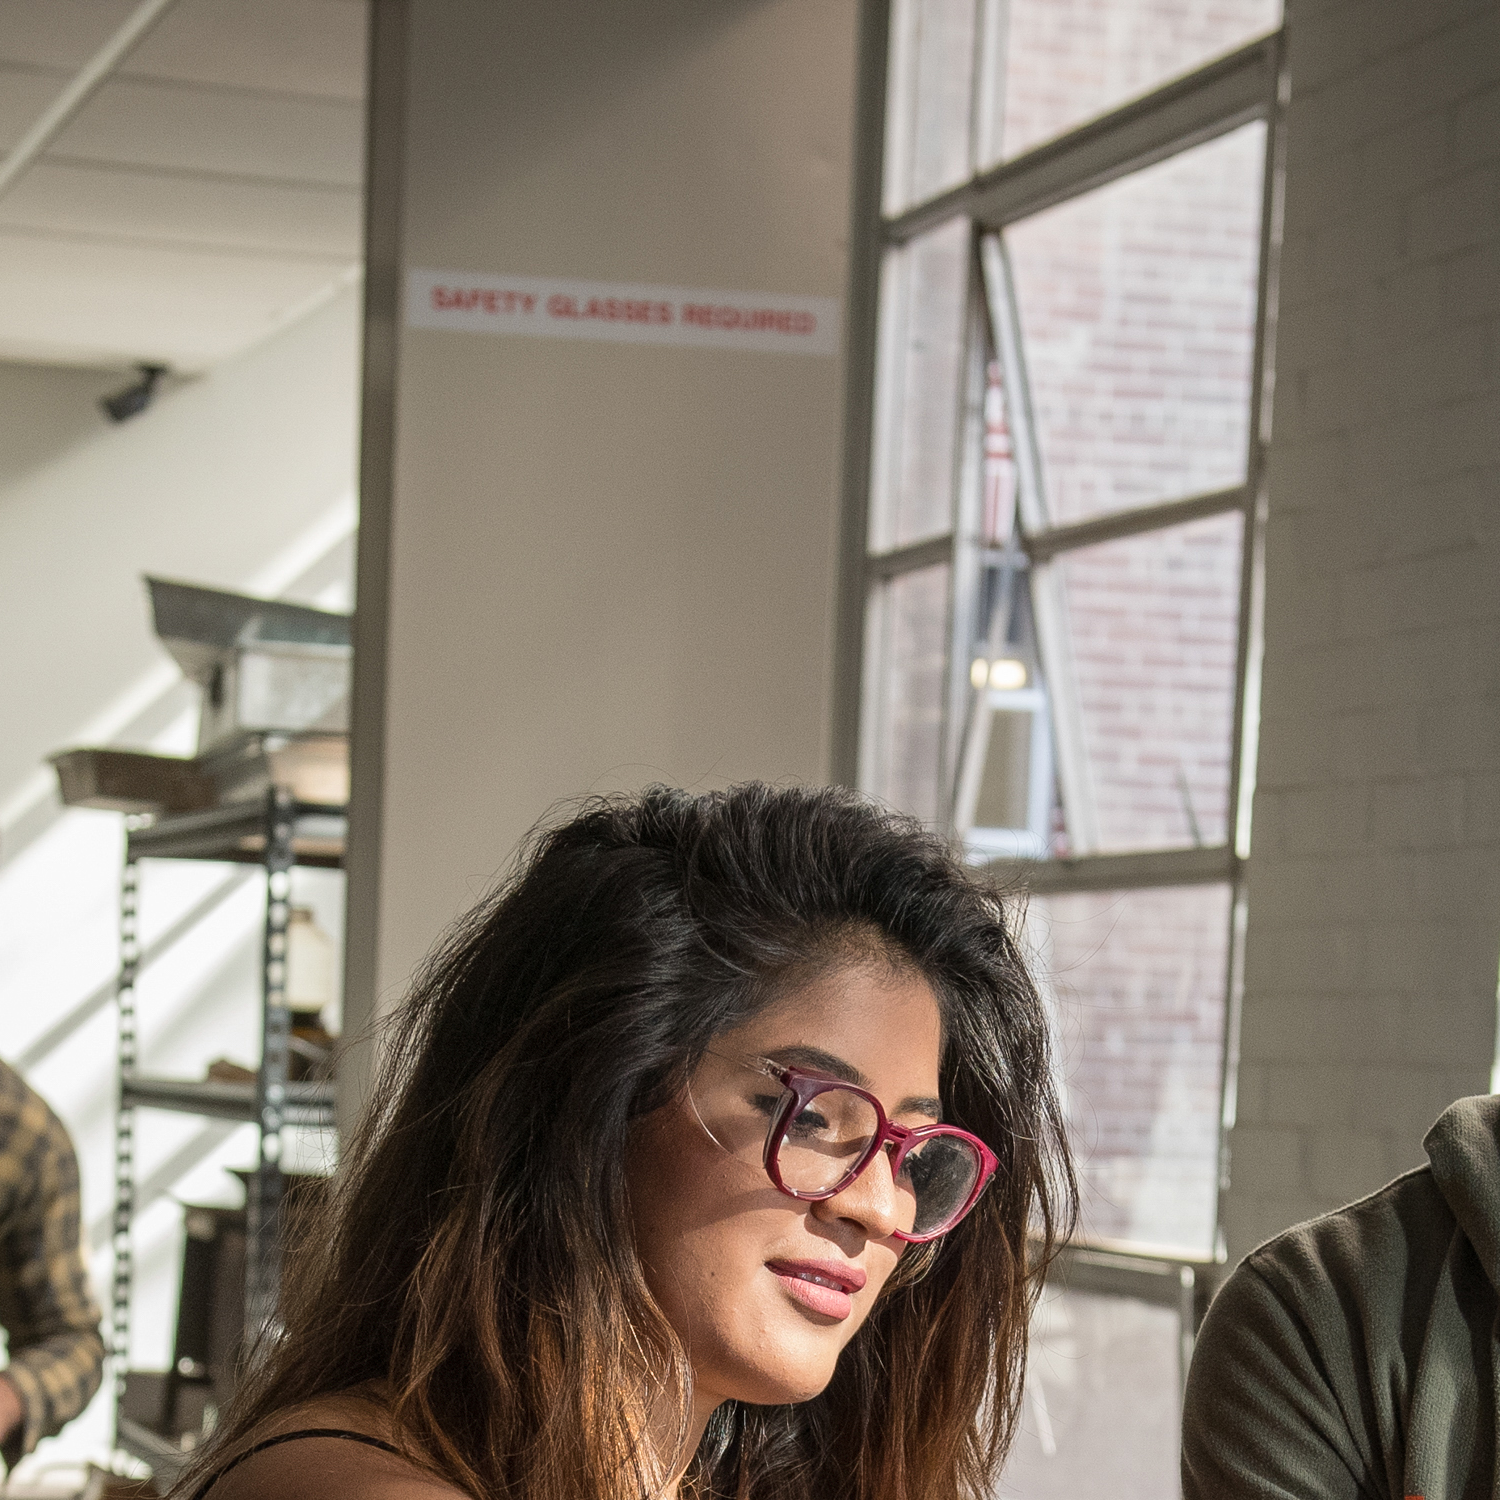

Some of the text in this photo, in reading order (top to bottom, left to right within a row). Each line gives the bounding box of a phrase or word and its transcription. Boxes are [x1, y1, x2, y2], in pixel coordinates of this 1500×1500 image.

[430, 285, 816, 336] SAFETY GLASSES REQUIRED
